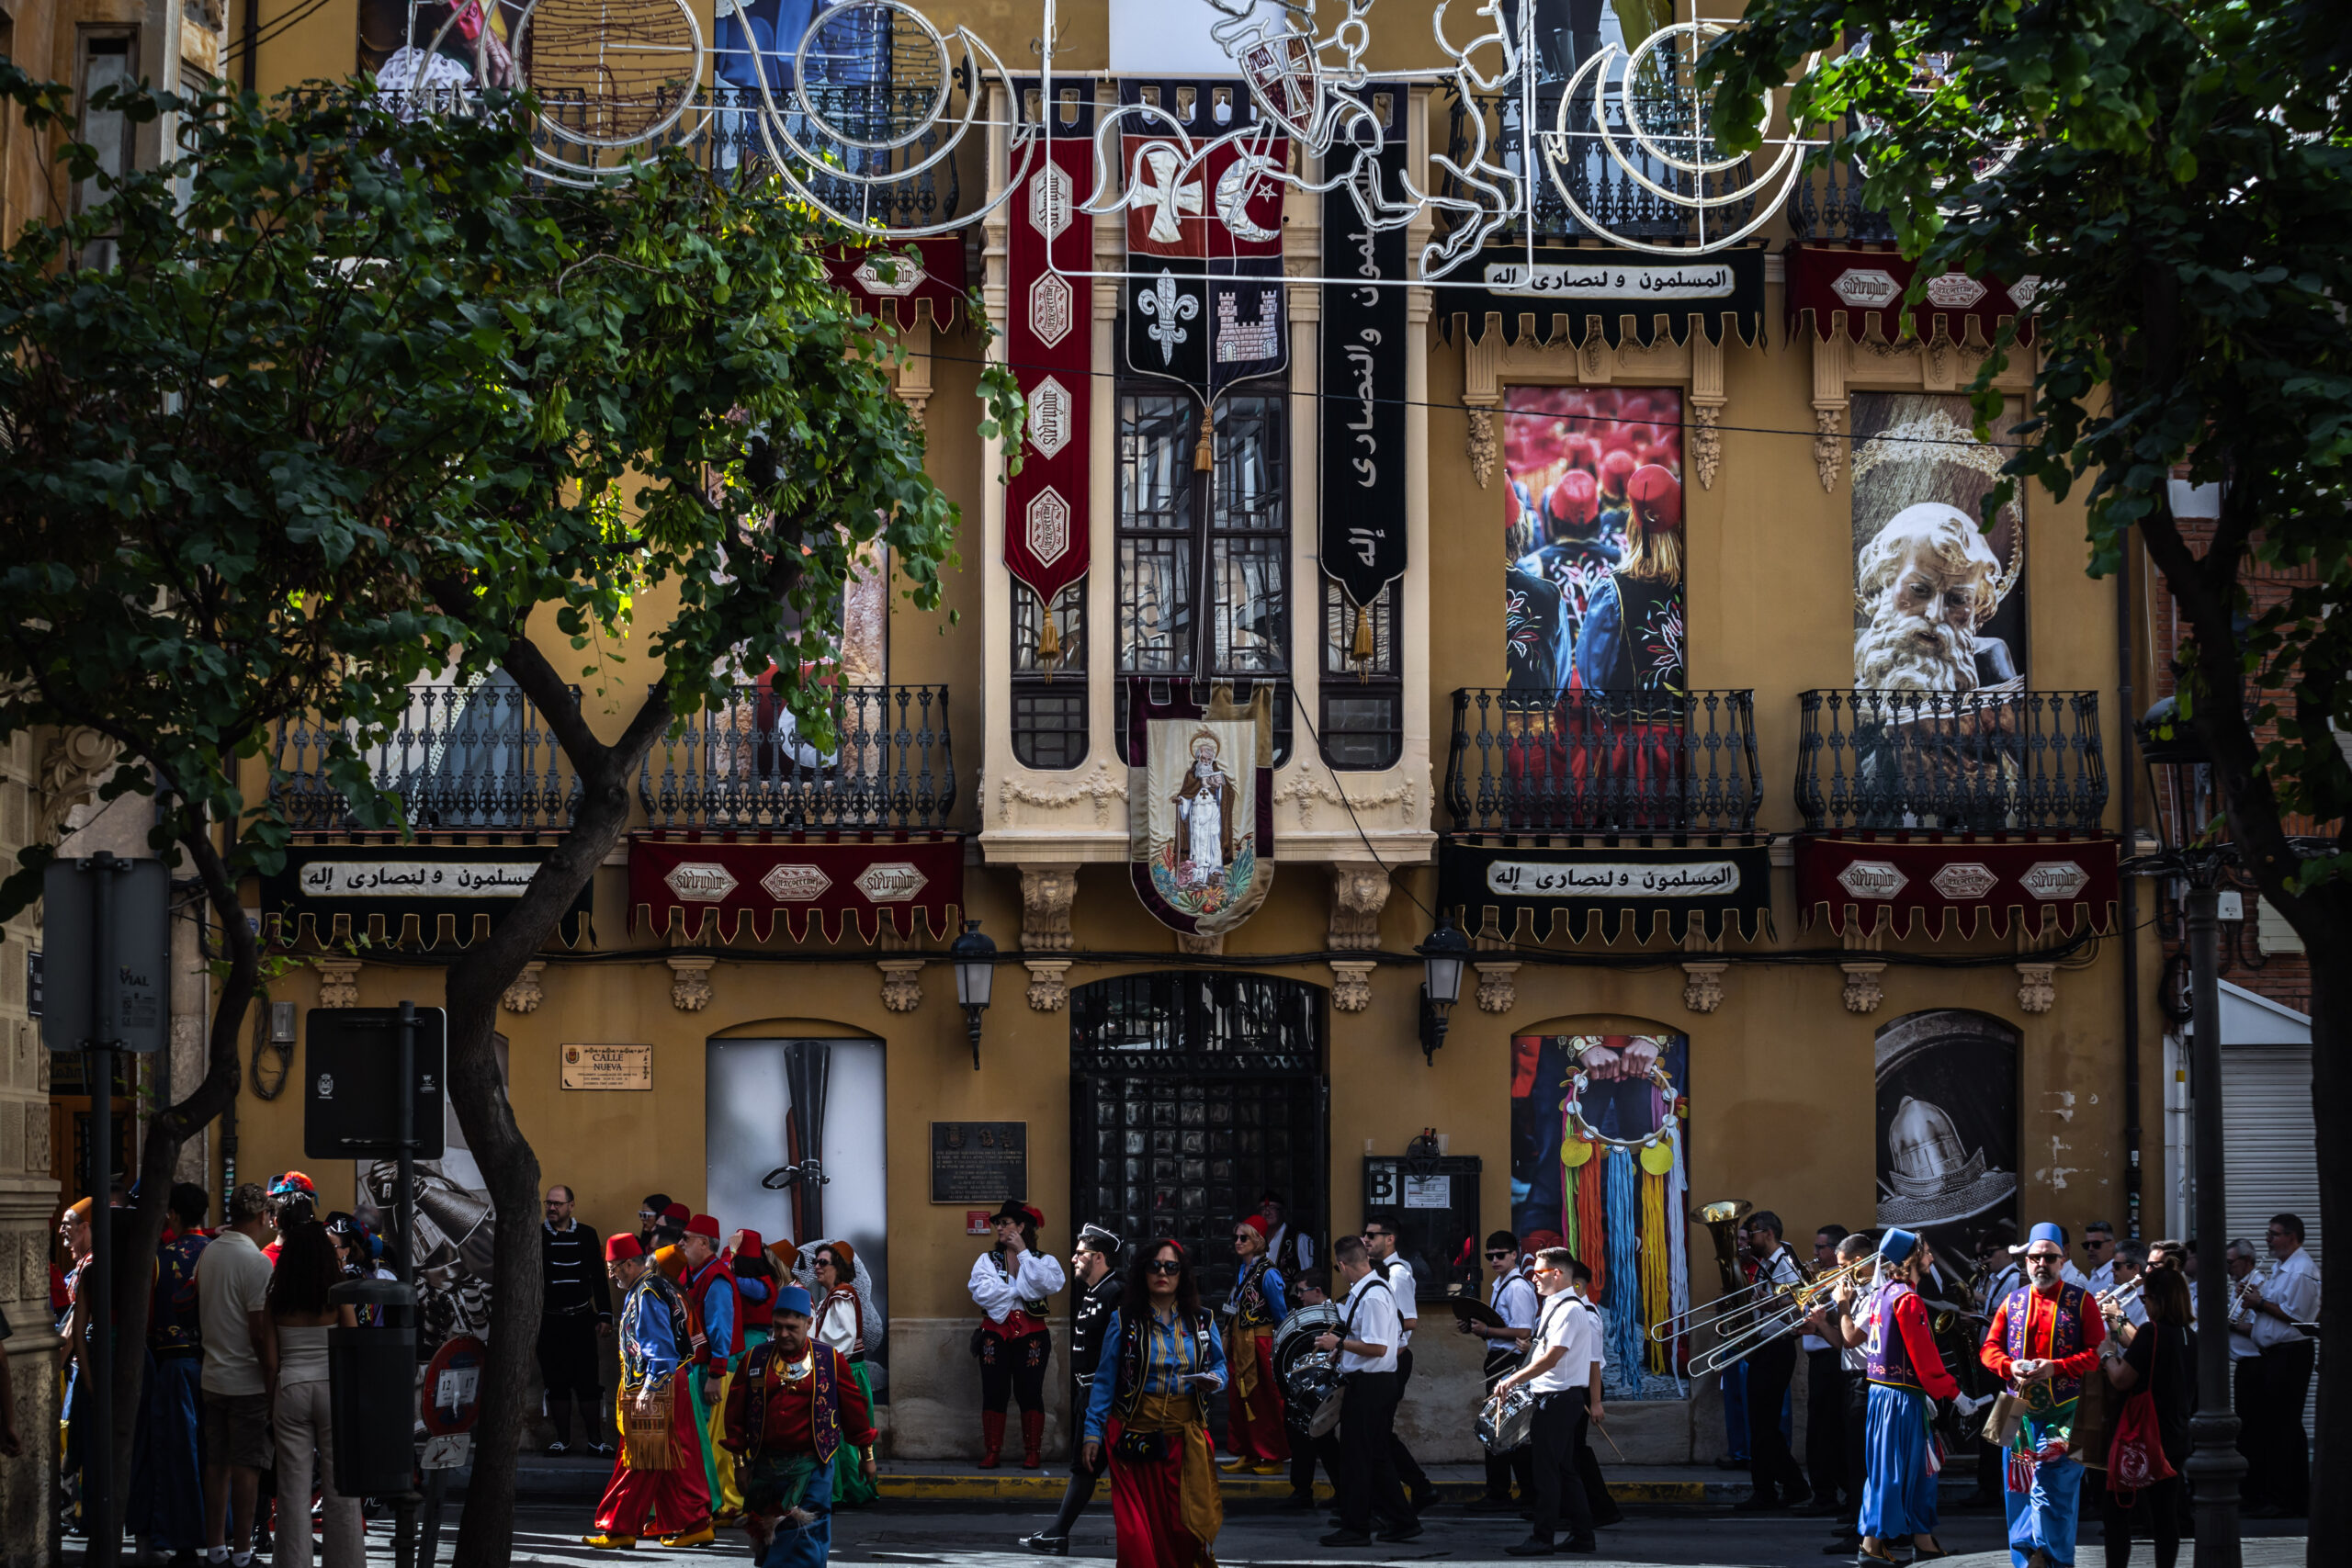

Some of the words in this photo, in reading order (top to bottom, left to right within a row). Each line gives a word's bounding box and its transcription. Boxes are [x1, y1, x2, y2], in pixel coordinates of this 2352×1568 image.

[1639, 269, 1727, 292] المسلمون
[1643, 866, 1731, 892] المسلمون
[119, 974, 150, 987] VIAL
[594, 1063, 623, 1071] NUEVA
[1371, 1170, 1393, 1198] B
[441, 1380, 451, 1392] 12
